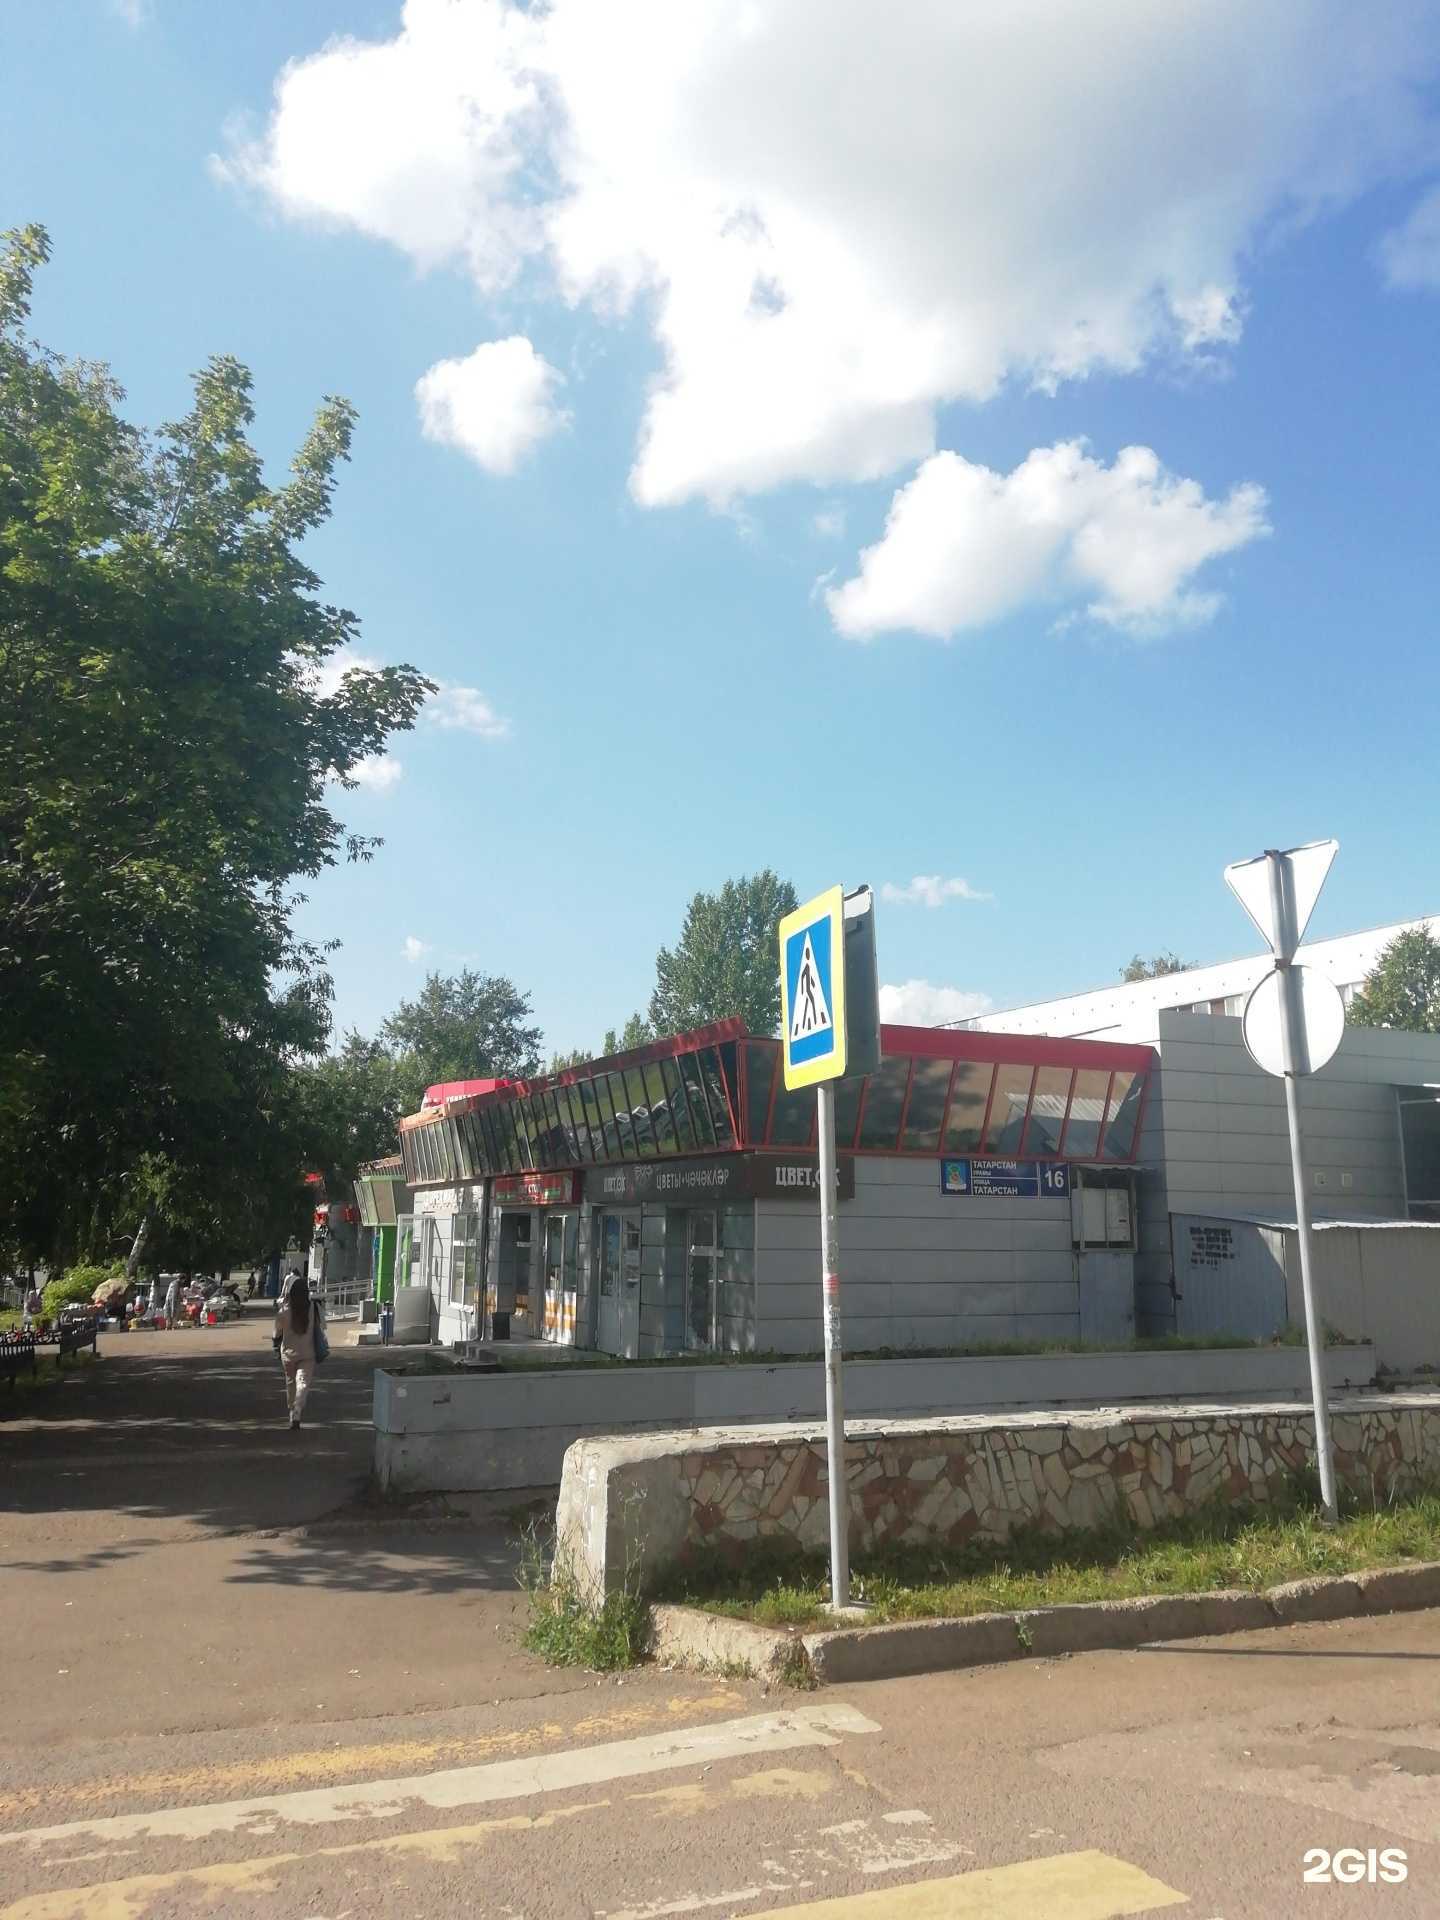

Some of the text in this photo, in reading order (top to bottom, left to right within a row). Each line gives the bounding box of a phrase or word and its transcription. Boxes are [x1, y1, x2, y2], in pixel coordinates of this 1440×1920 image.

[973, 1160, 1017, 1170] ТАТАРСТАН
[1044, 1170, 1065, 1188] 16
[973, 1186, 1018, 1195] ТАТАРСТАН
